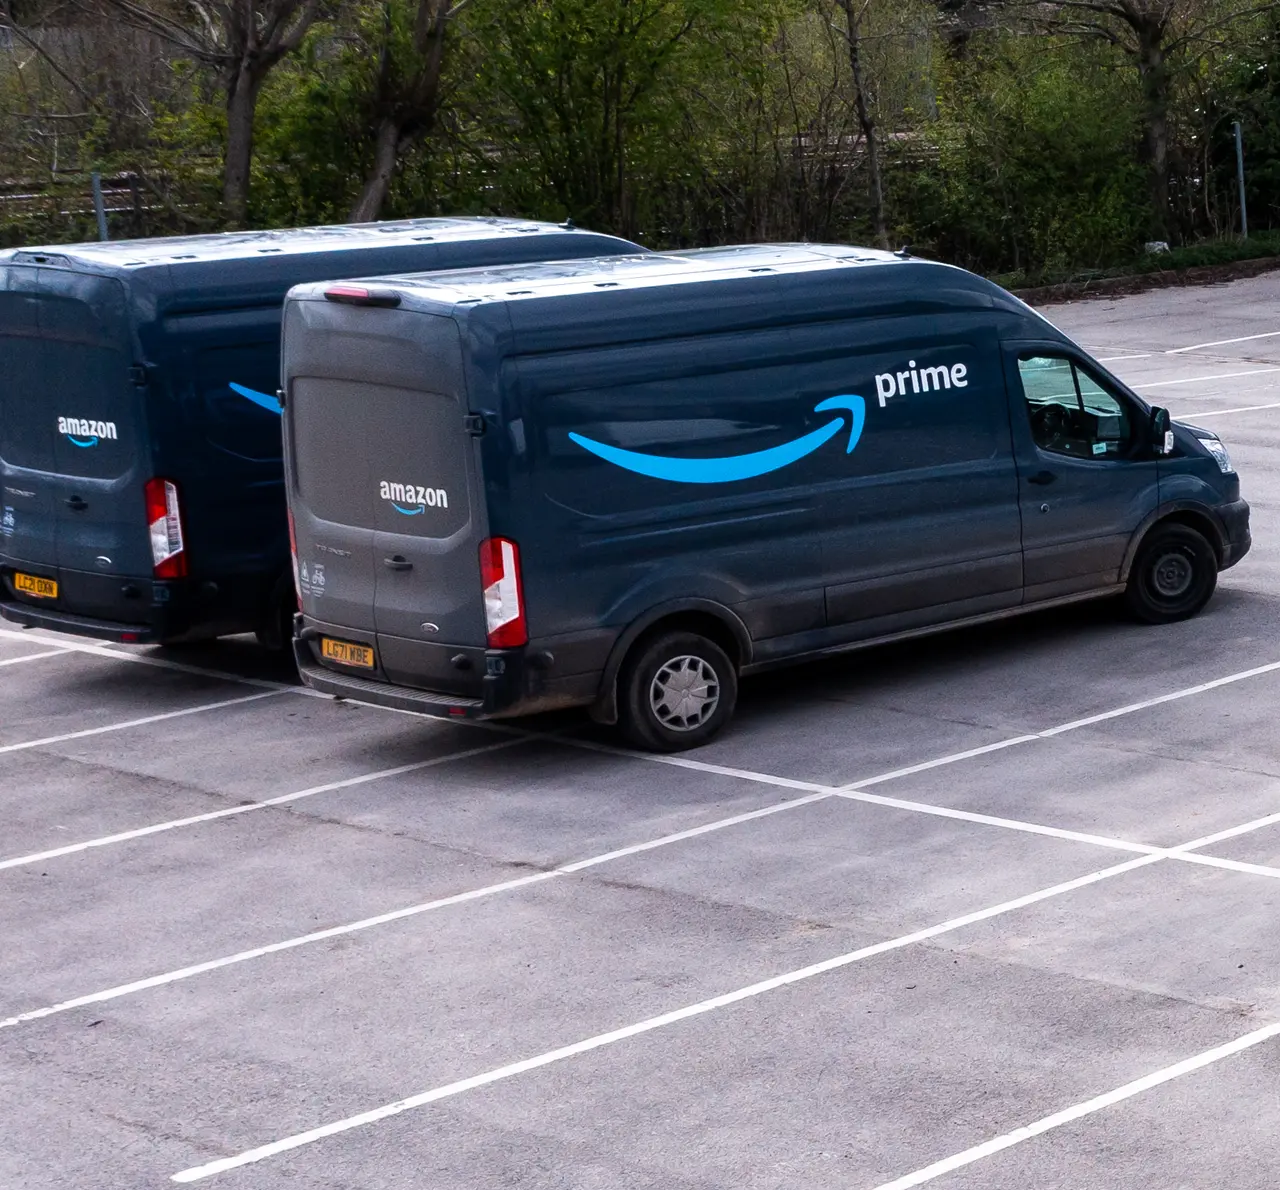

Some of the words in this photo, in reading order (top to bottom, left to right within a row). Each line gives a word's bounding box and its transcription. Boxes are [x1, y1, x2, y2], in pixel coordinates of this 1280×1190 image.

[874, 360, 968, 408] prime
[58, 416, 118, 440] amazon
[380, 480, 449, 509] amazon
